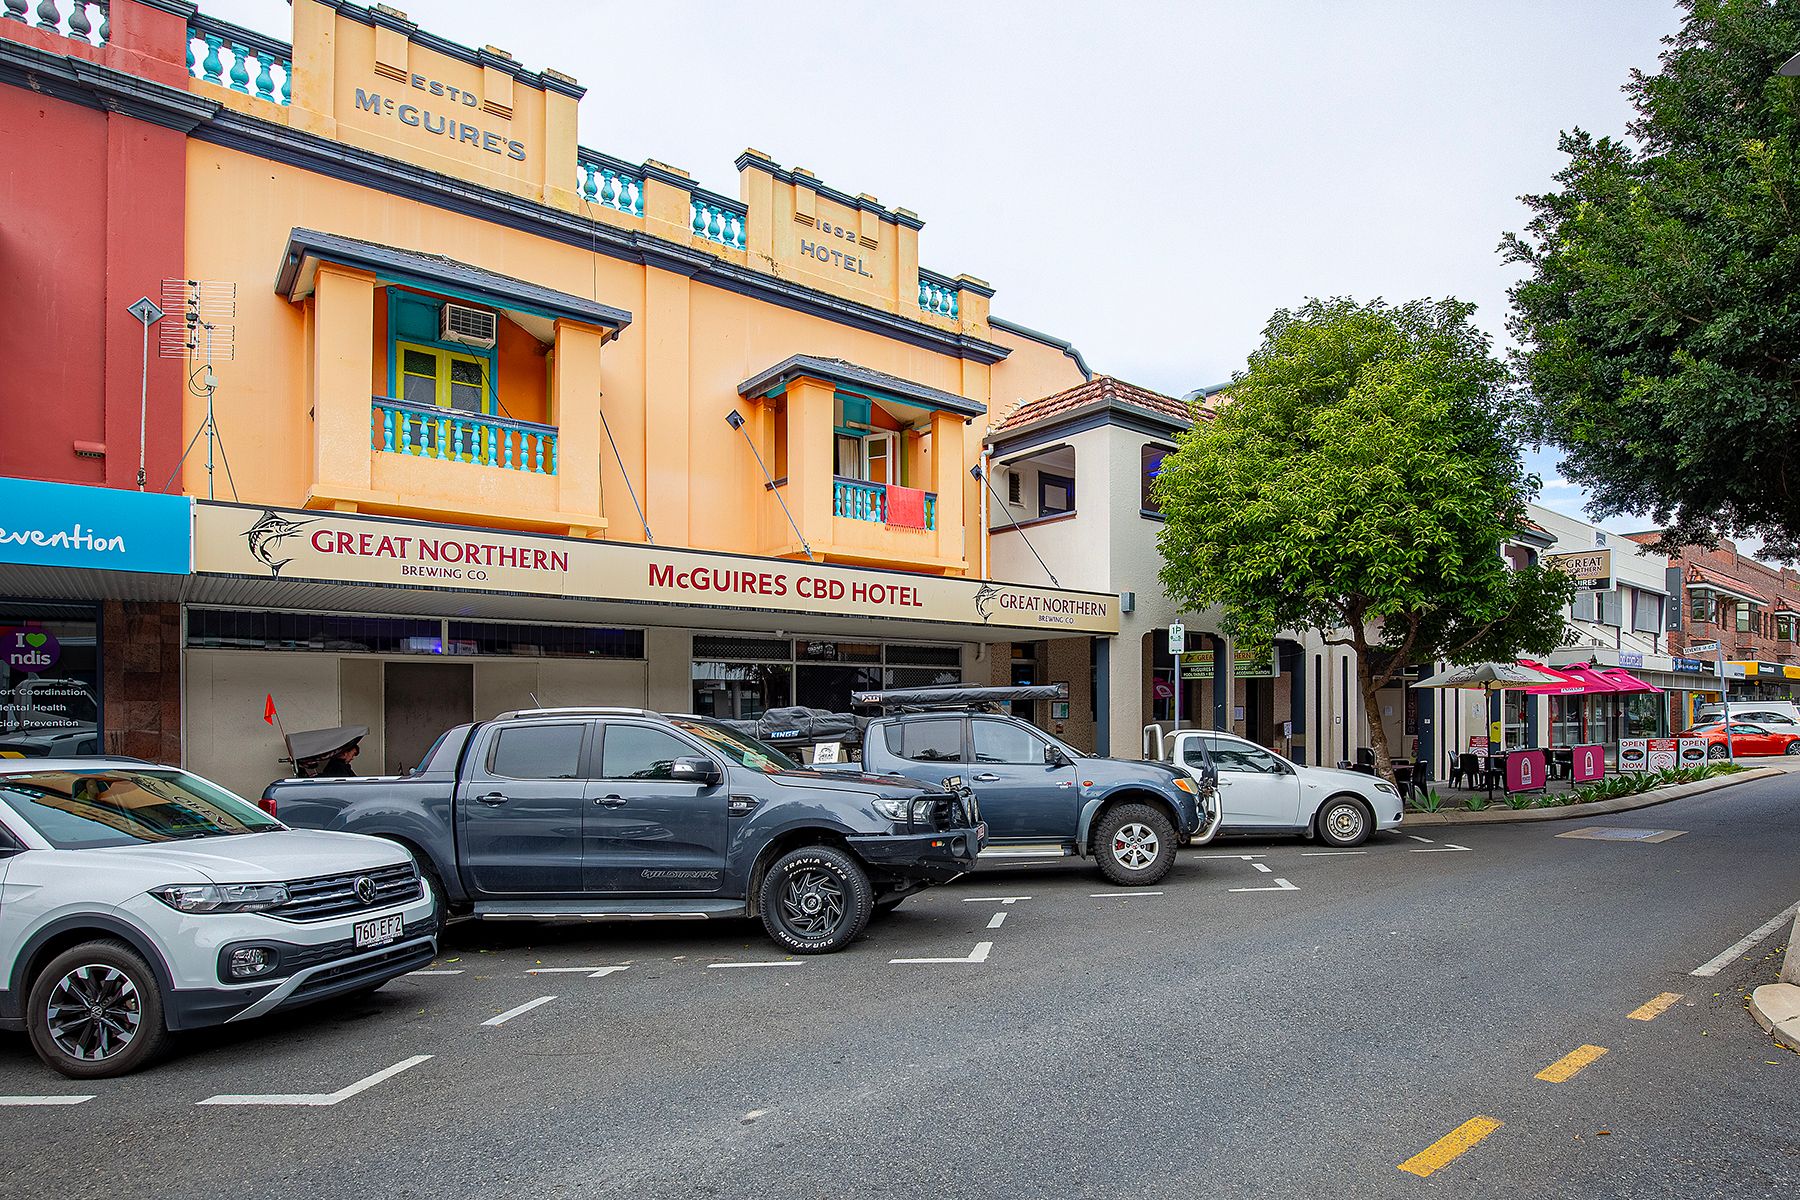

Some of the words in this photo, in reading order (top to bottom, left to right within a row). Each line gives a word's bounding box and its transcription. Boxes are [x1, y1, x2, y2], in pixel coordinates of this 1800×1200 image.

[310, 529, 412, 560] GREAT
[418, 538, 569, 572] NORTHERN
[1565, 556, 1603, 569] GREAT
[401, 564, 462, 580] BREWING
[467, 569, 489, 582] CO.
[649, 563, 788, 596] McGUIRES
[796, 576, 845, 601] CBD
[852, 581, 923, 608] HOTEL
[999, 593, 1041, 612] GREAT
[1042, 597, 1107, 617] NORTHERN
[1038, 614, 1064, 624] BREWING
[15, 632, 26, 648] I
[10, 650, 51, 665] ndis
[19, 687, 87, 696] Coordination
[32, 703, 67, 712] Health
[23, 719, 79, 727] Prevention
[771, 729, 800, 739] KINGS
